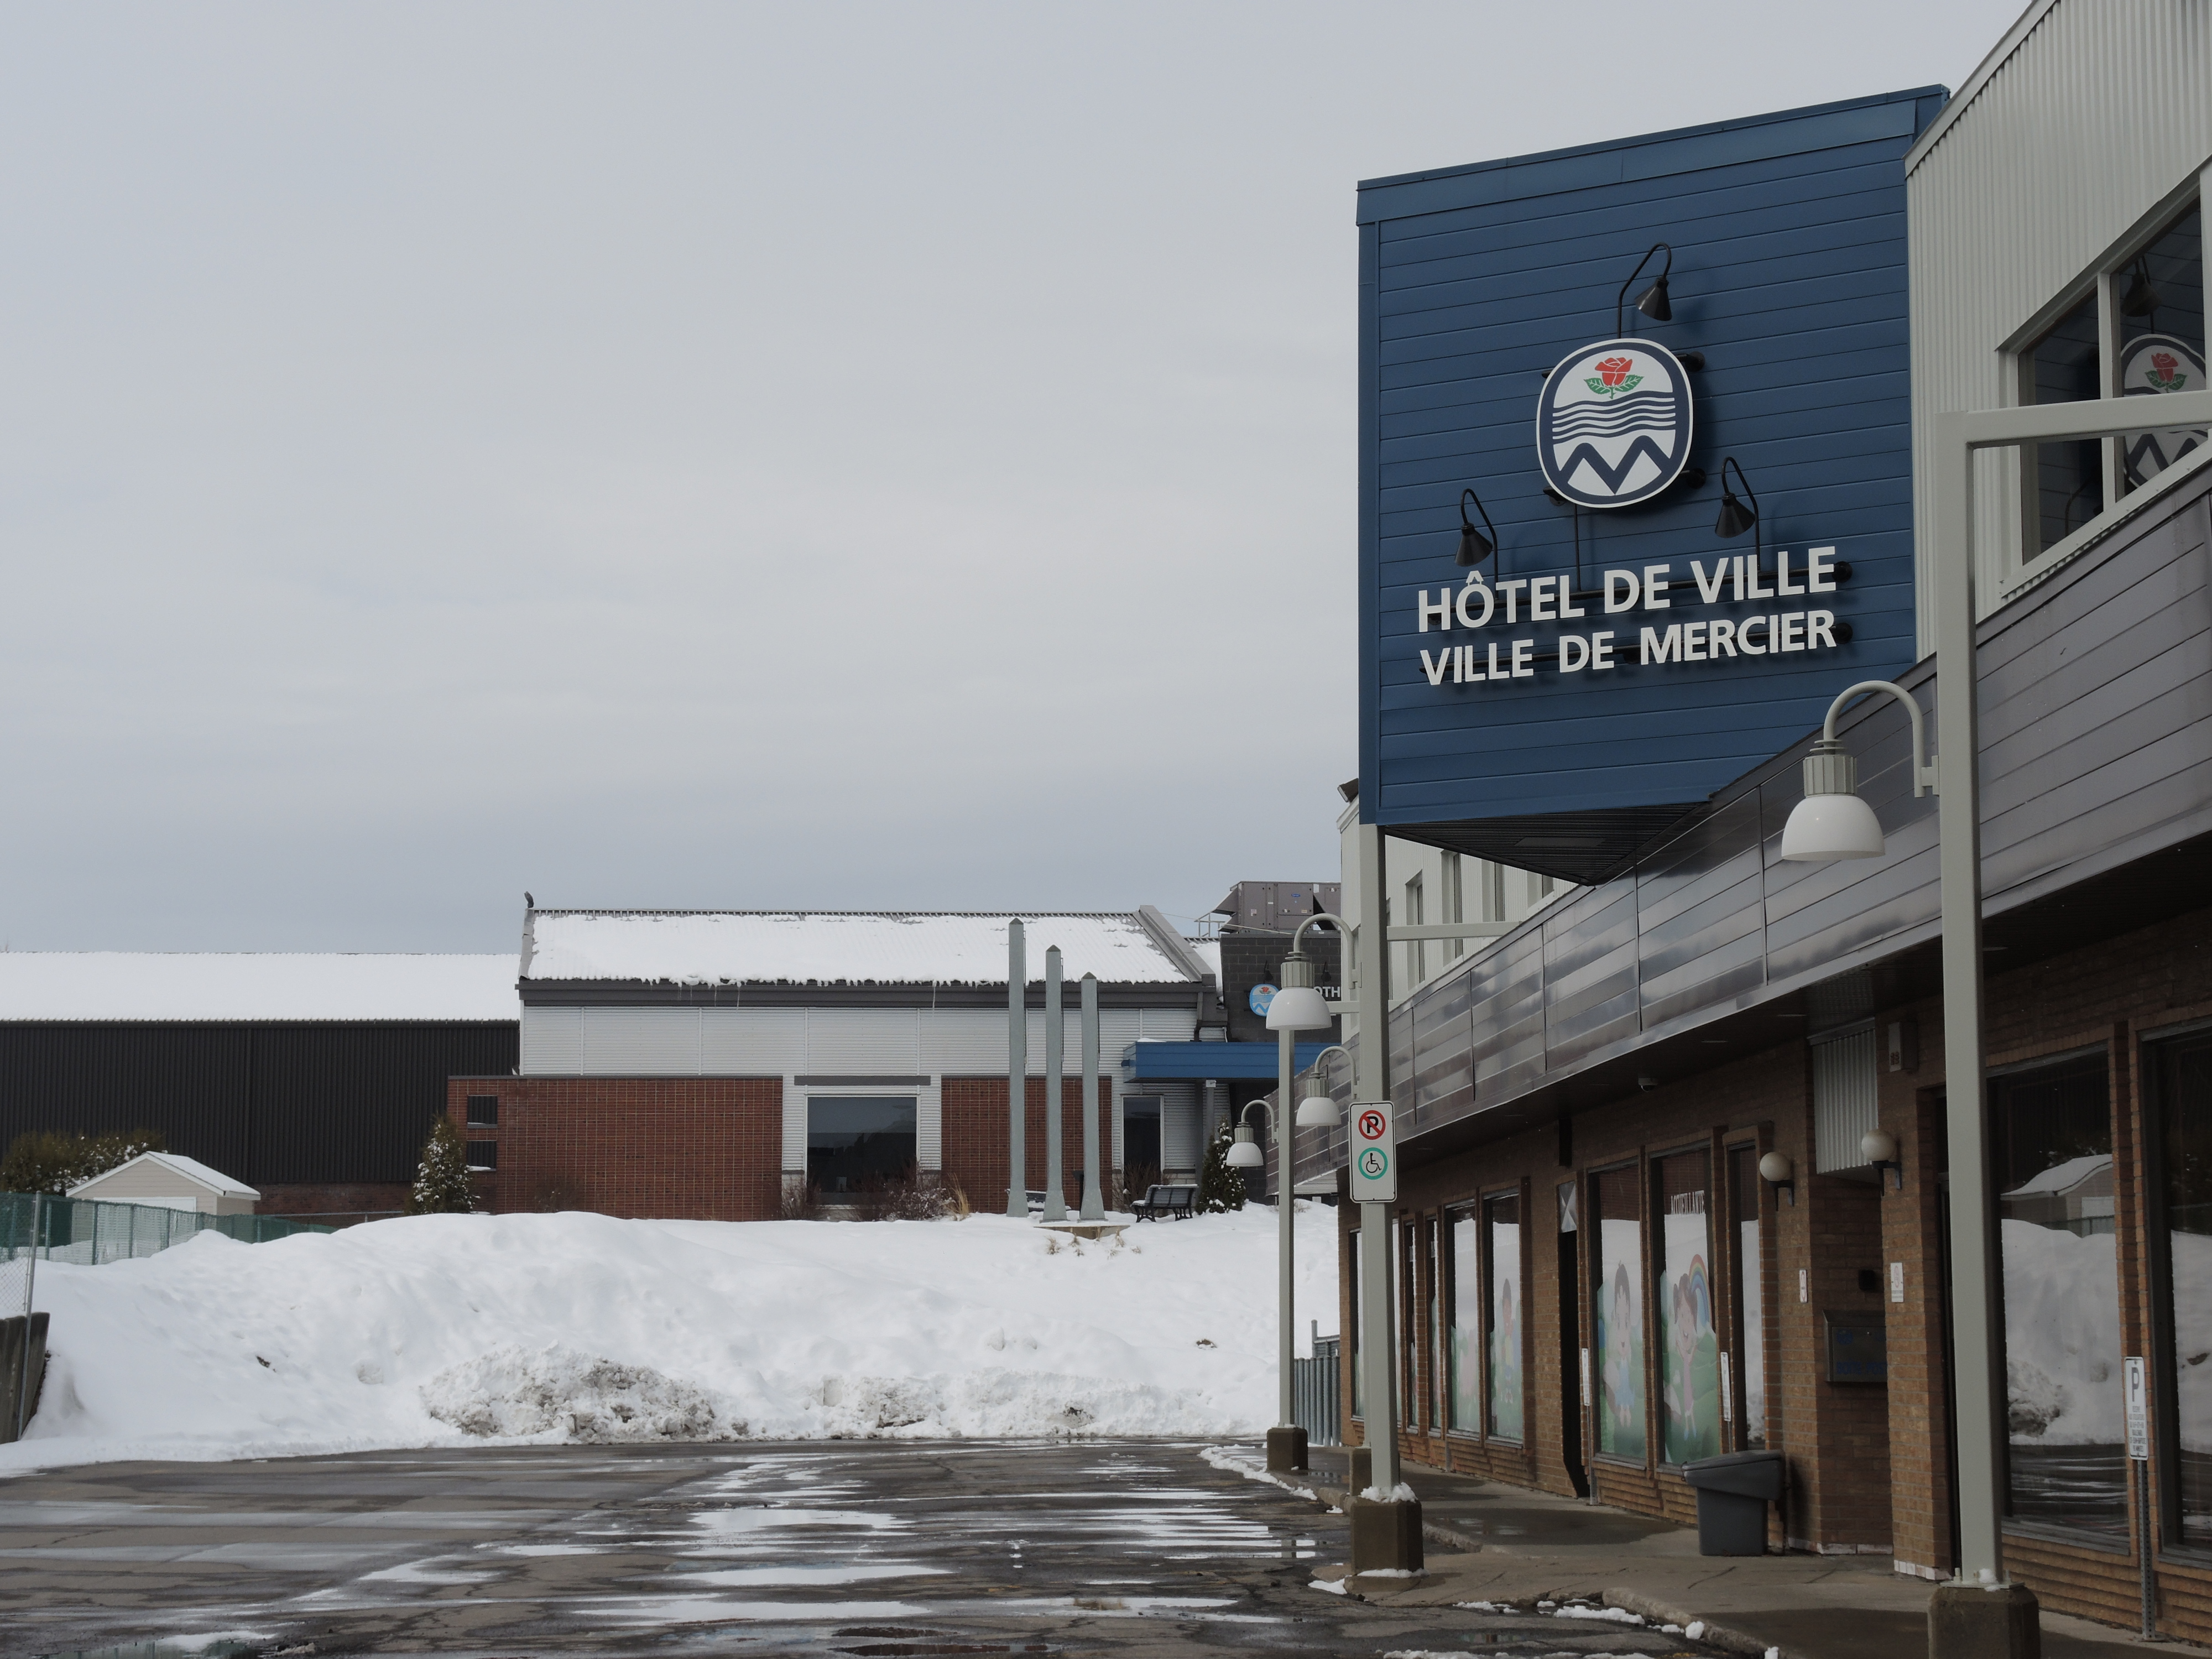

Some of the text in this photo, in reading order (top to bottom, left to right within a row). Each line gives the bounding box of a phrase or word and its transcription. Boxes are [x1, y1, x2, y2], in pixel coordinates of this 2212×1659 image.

[1418, 546, 1836, 632] HÔTEL DE VILLE
[1420, 609, 1837, 685] VILLE DE MERCIER
[2131, 1367, 2140, 1402] P
